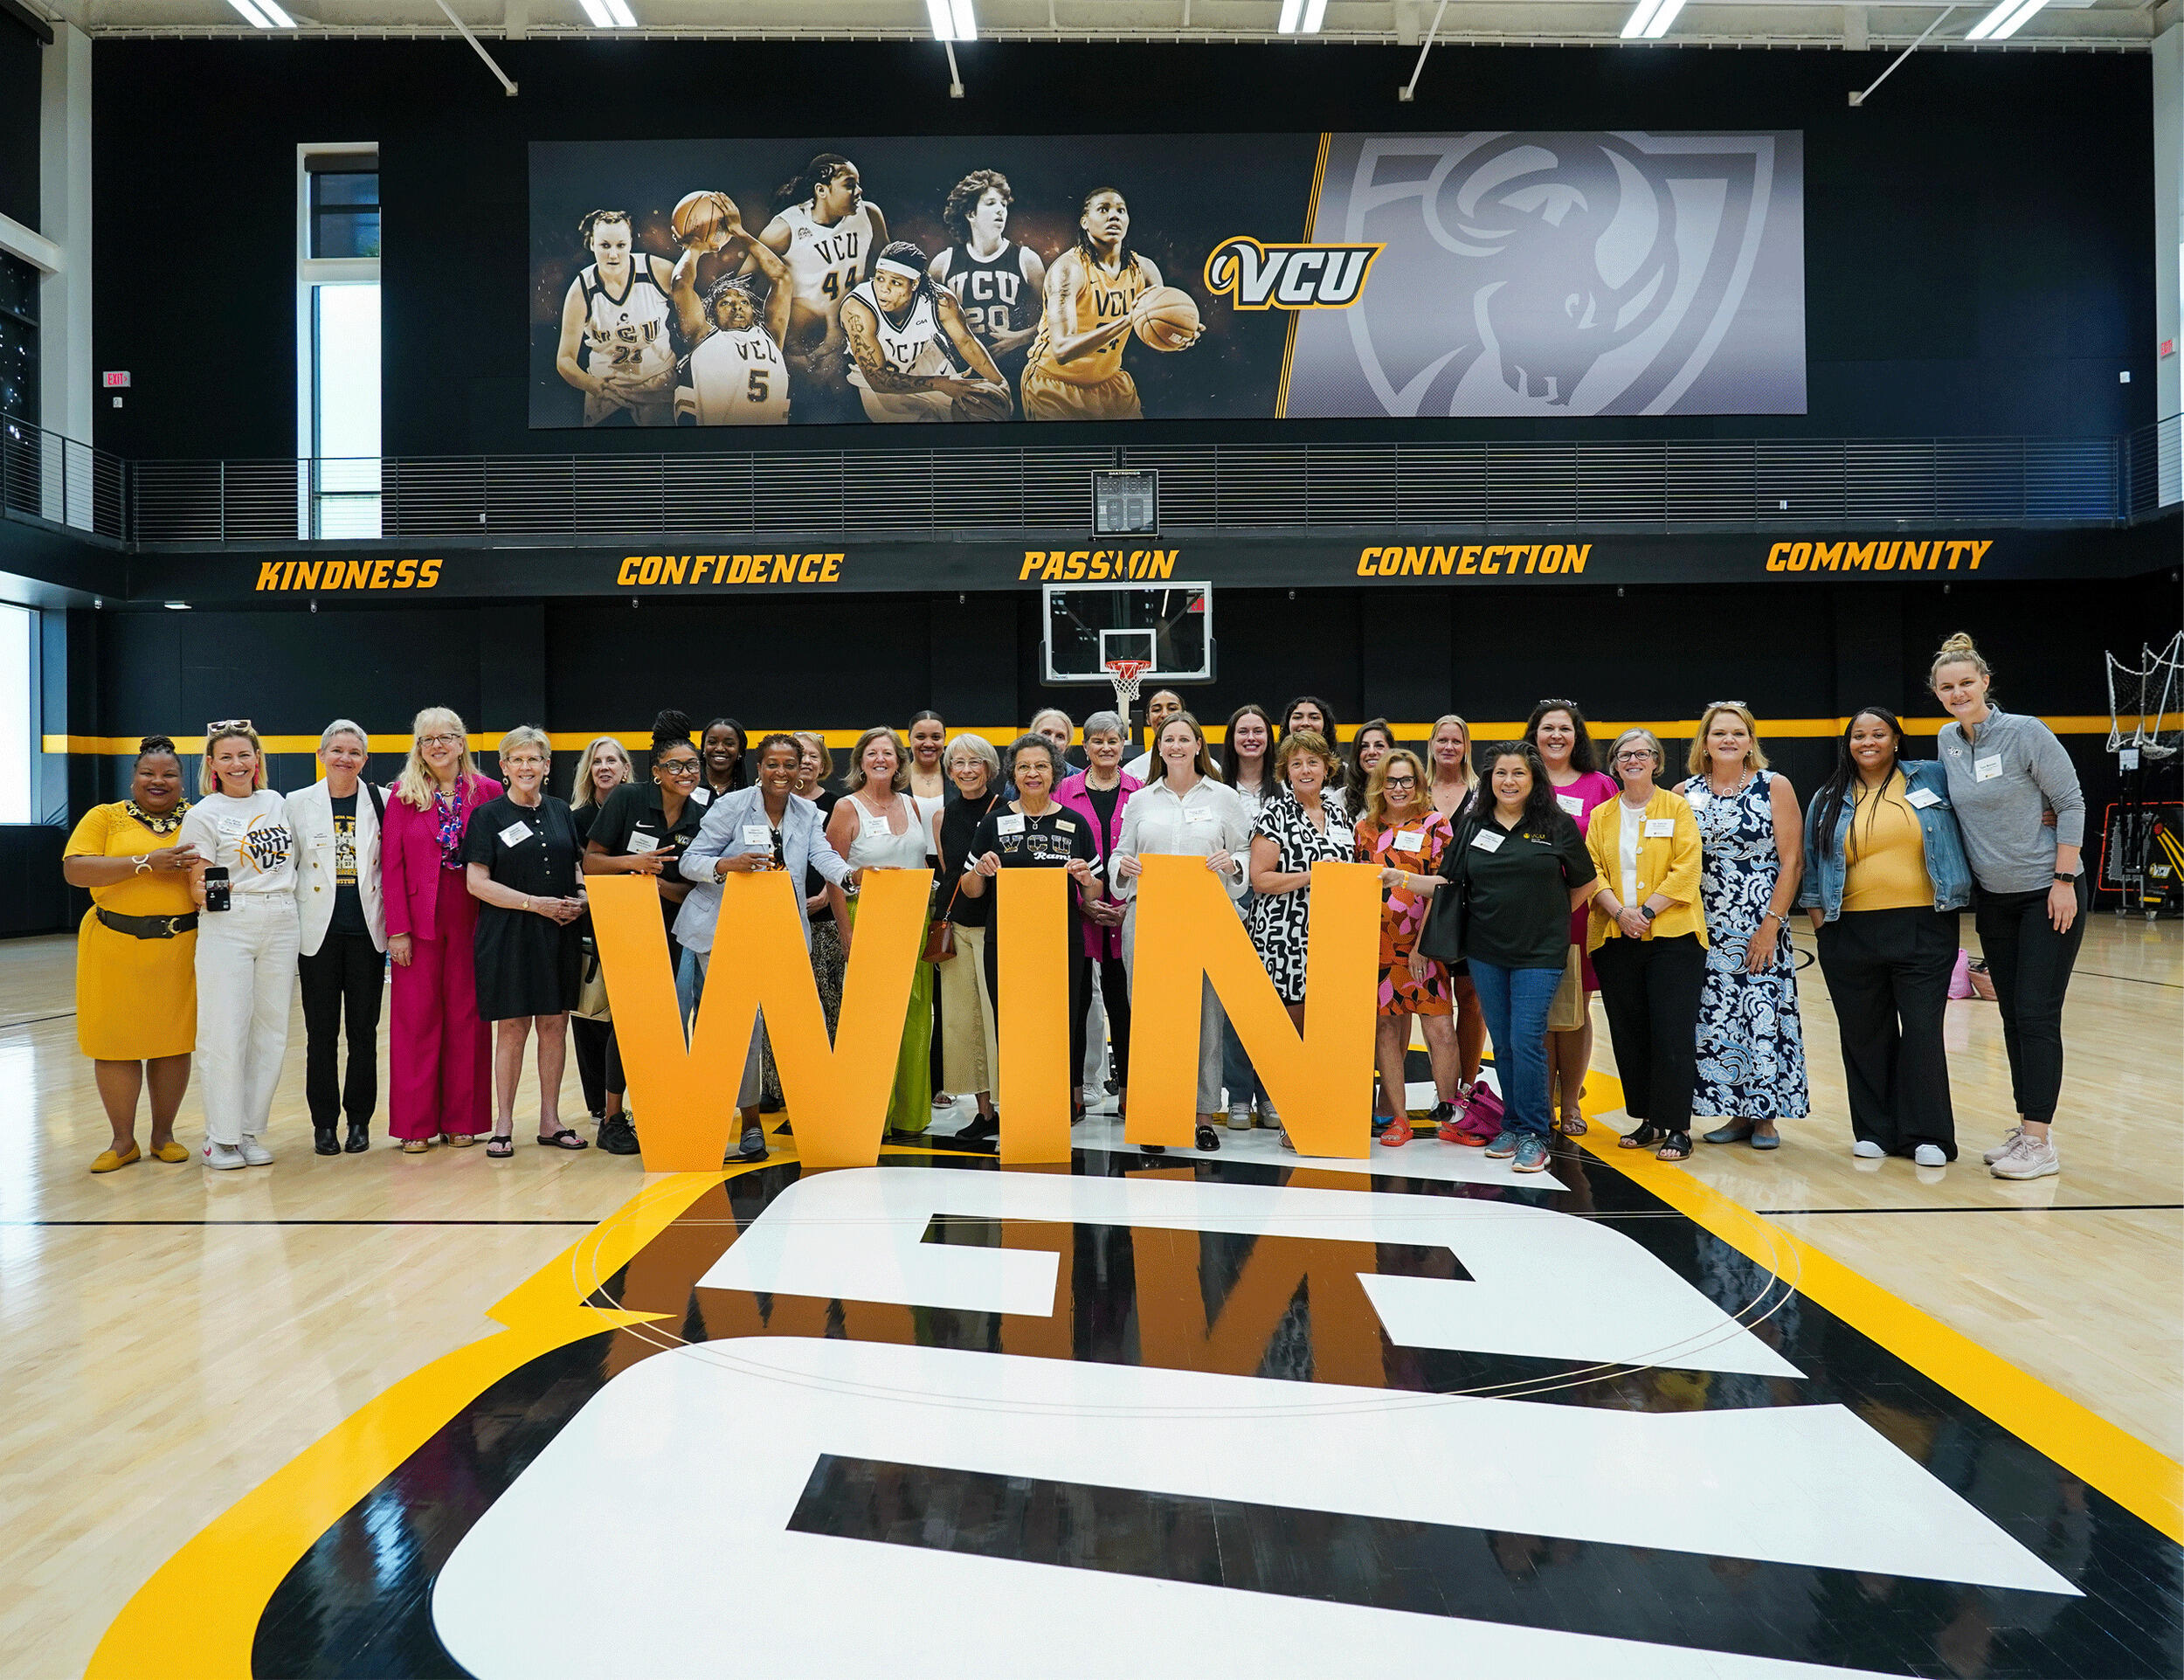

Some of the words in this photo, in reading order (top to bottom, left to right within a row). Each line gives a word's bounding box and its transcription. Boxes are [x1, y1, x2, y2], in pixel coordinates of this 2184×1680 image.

[813, 232, 858, 265] VCU
[821, 265, 858, 301] 44
[947, 270, 1020, 306] VCU
[1211, 242, 1374, 304] VCU
[964, 305, 1010, 334] 20
[107, 373, 123, 385] EXIT
[747, 368, 770, 404] 5
[617, 553, 845, 585] CONFIDENCE
[1357, 543, 1593, 577] CONNECTION
[1766, 540, 1993, 572] COMMUNITY
[255, 559, 443, 591] KINDNESS
[246, 824, 287, 844] RUN
[248, 834, 293, 859] WITH
[999, 834, 1072, 855] VCU
[262, 851, 287, 869] US
[584, 854, 1385, 1173] WIN
